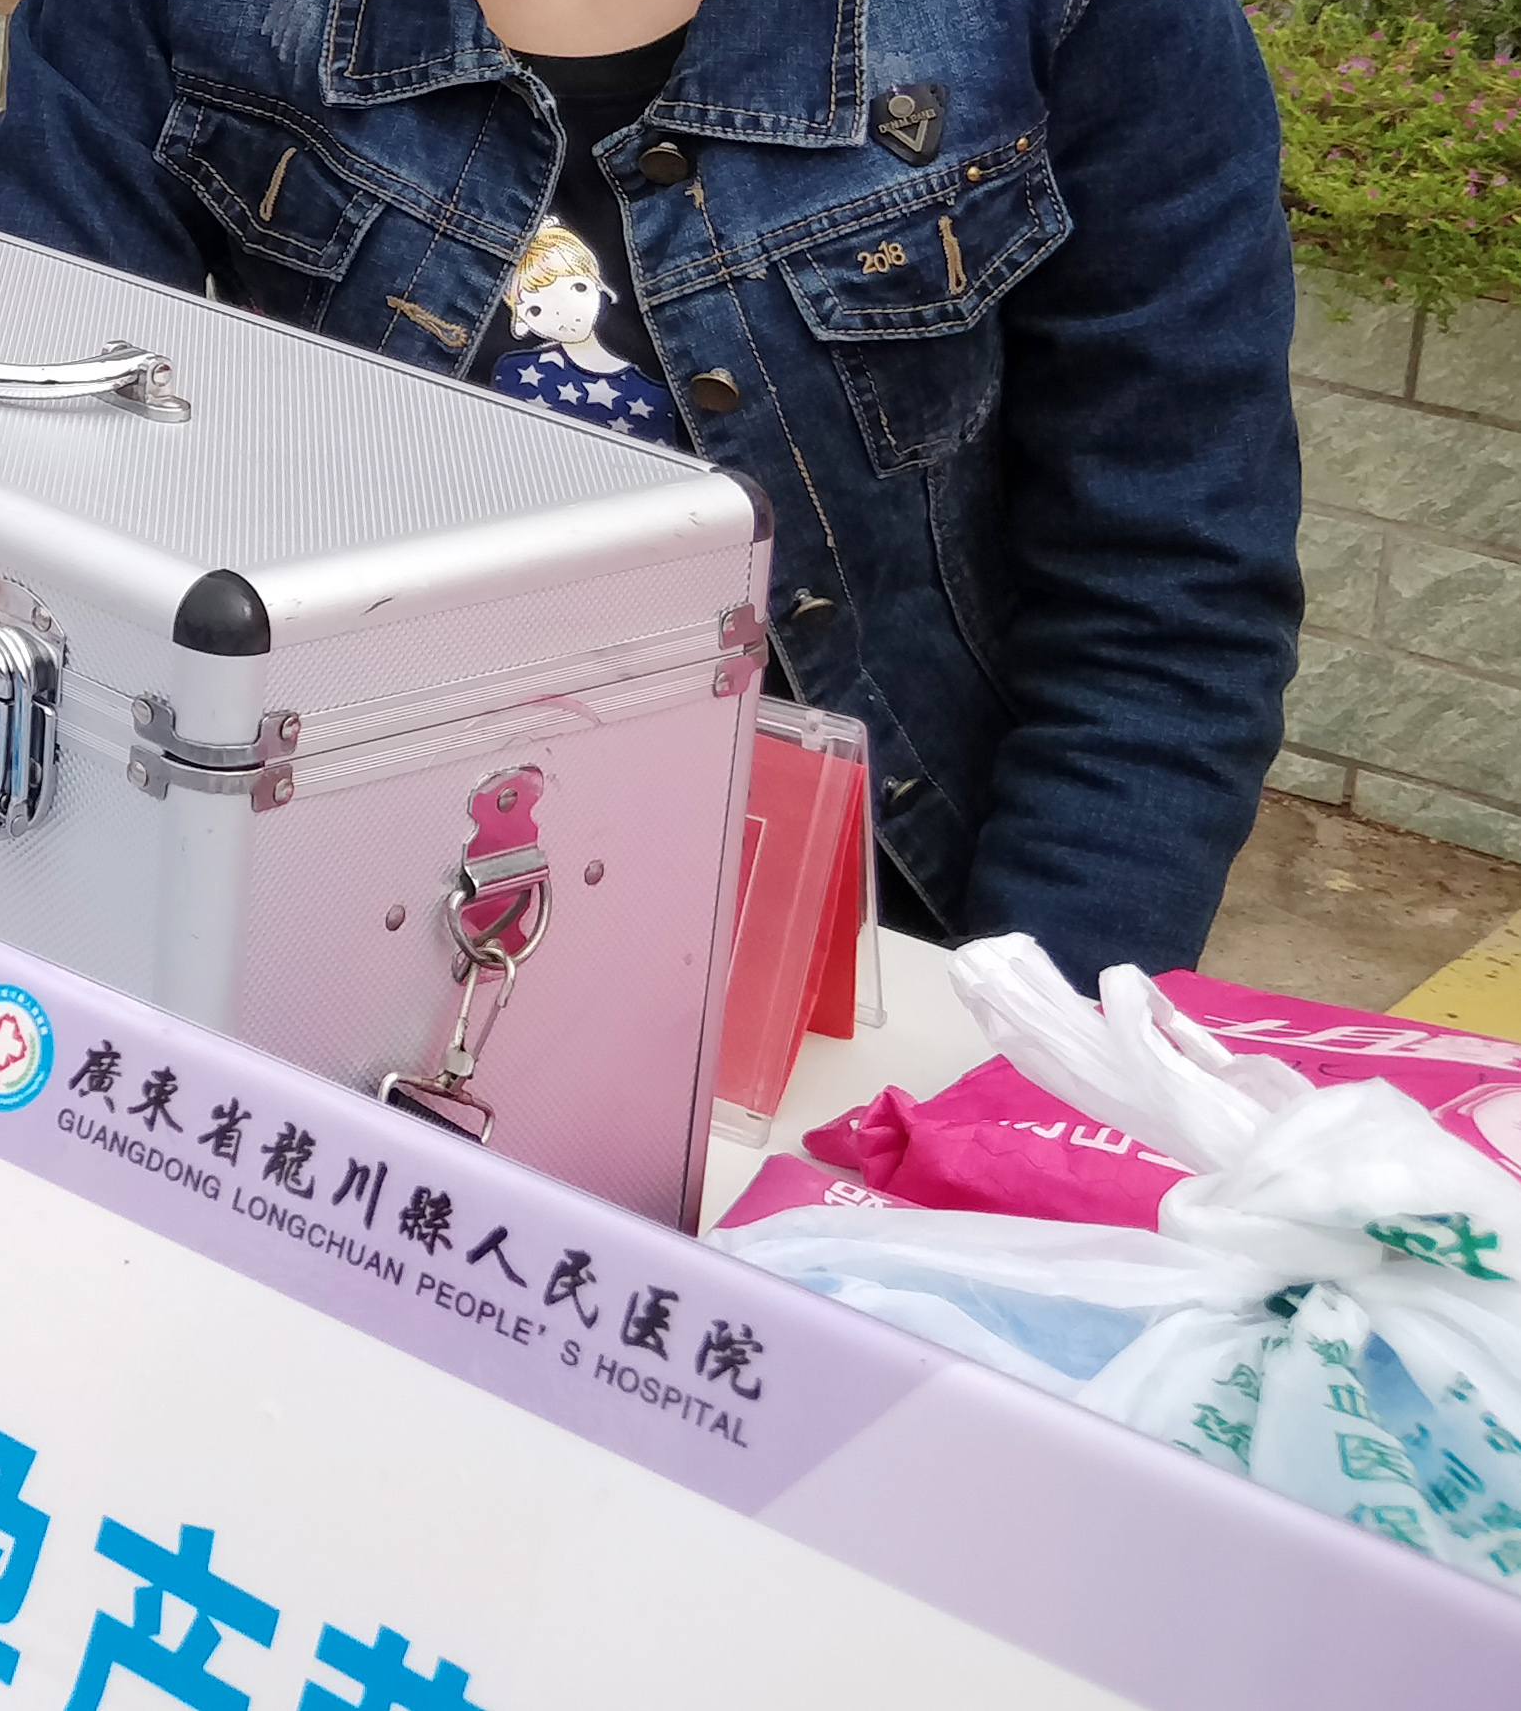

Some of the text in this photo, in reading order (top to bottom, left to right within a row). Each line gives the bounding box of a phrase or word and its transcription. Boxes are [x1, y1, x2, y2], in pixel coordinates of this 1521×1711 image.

[856, 240, 908, 275] 2018
[56, 1107, 222, 1202] GUANGDONG
[231, 1187, 405, 1287] LONGCHUAN
[593, 1353, 750, 1449] HOSPITAL
